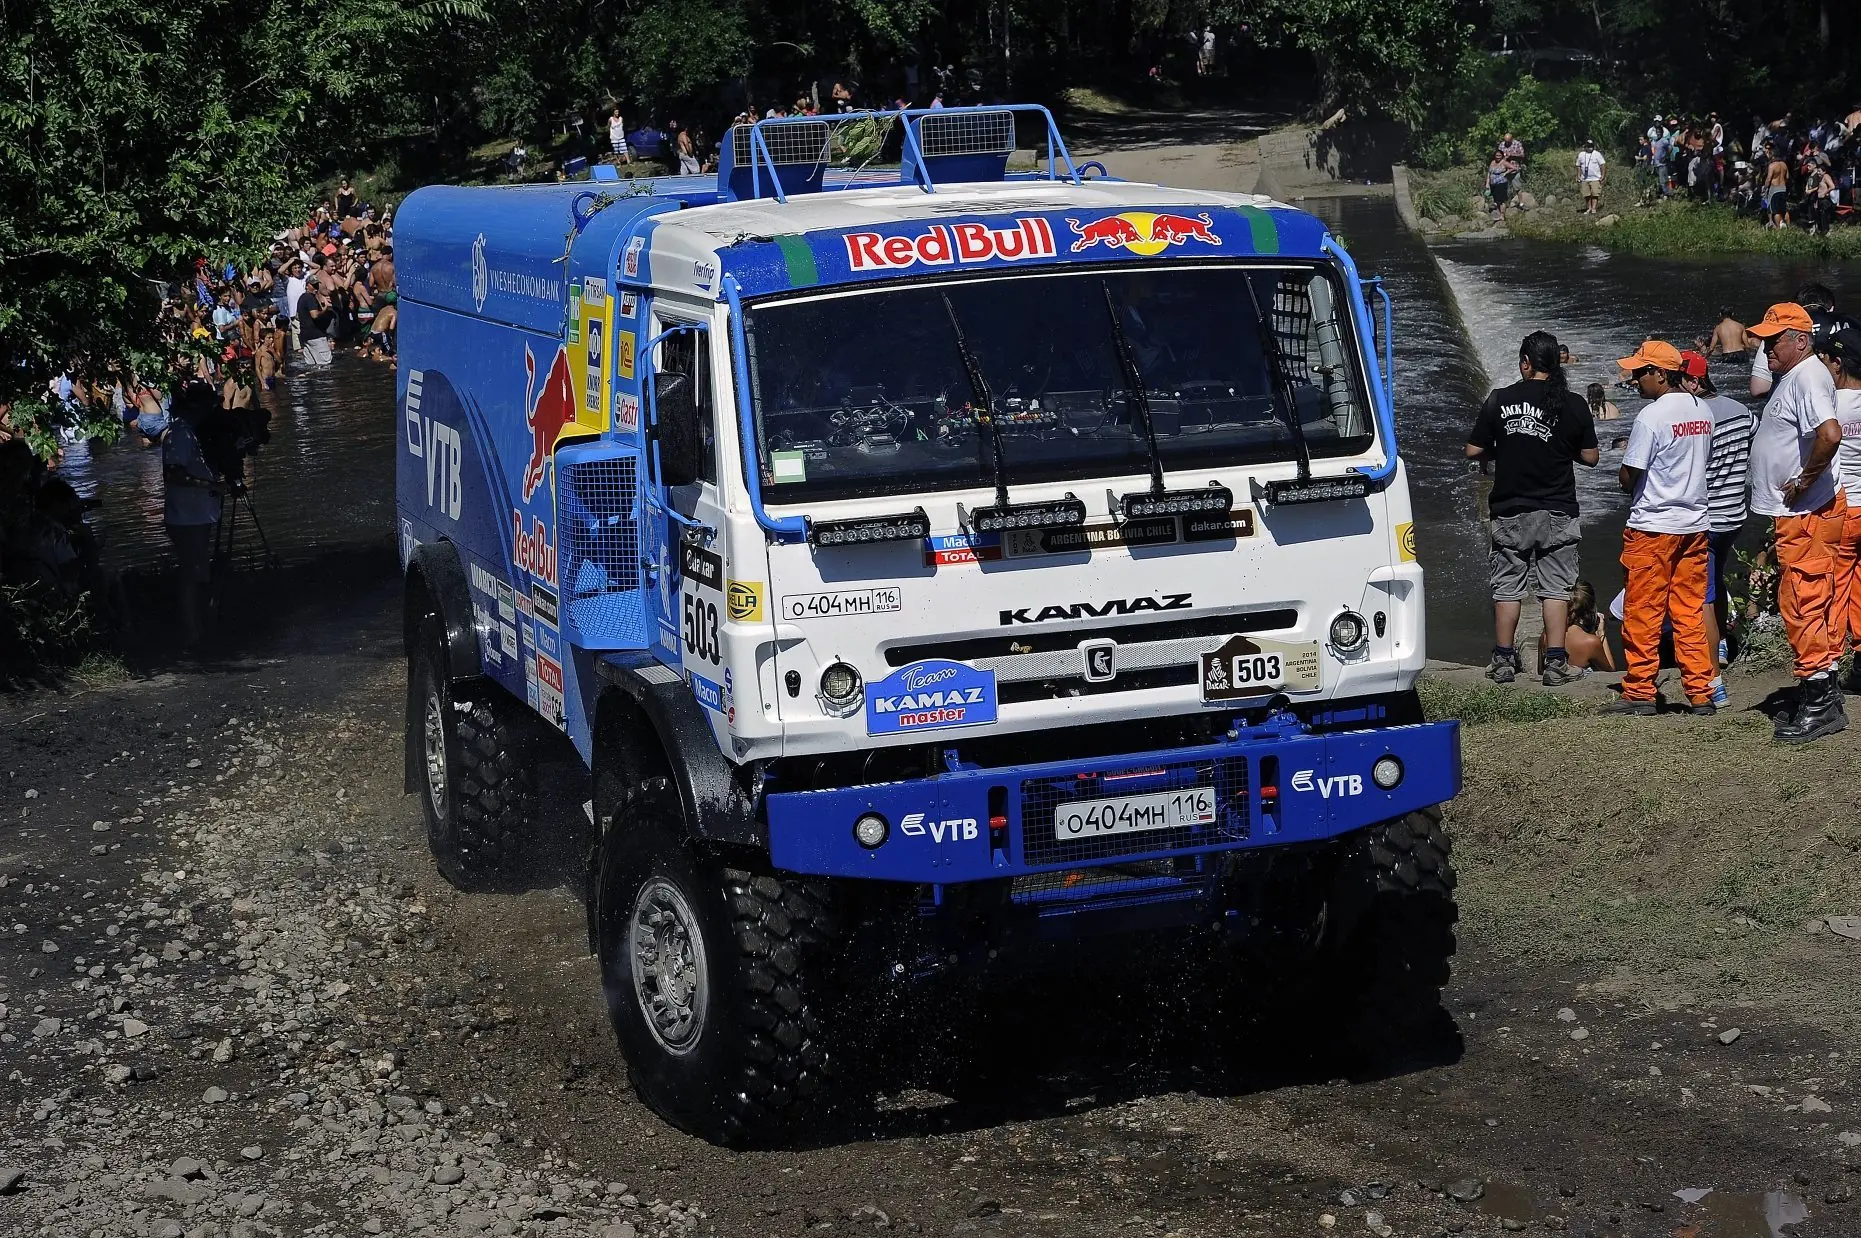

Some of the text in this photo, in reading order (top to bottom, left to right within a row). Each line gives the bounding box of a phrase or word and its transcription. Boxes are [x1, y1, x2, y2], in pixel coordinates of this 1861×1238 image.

[844, 218, 1055, 269] Red Bull
[489, 269, 560, 302] VNESHECONOMBANK
[1500, 404, 1522, 419] JACK
[1671, 420, 1712, 438] BOMBEROS
[425, 416, 462, 521] VTB
[1050, 524, 1172, 546] ARGENTINA BOLIVIA CHILE
[1190, 519, 1246, 533] dakar.com
[514, 507, 537, 576] Red
[943, 537, 982, 549] Macro
[471, 562, 498, 600] WABCO
[875, 590, 895, 603] 116
[876, 603, 891, 611] RUS
[999, 592, 1193, 626] KAMAZ
[684, 592, 721, 667] 503
[1237, 655, 1281, 683] 503
[1285, 658, 1317, 667] ARGENTINA
[1296, 665, 1317, 673] BOLIVIA
[901, 666, 957, 691] Team
[694, 677, 719, 706] Macro
[875, 687, 984, 713] KAMAZ
[900, 708, 966, 726] master
[1316, 774, 1363, 799] VTB
[1171, 792, 1208, 815] 116
[1179, 813, 1199, 822] RUS
[928, 818, 978, 844] VTB
